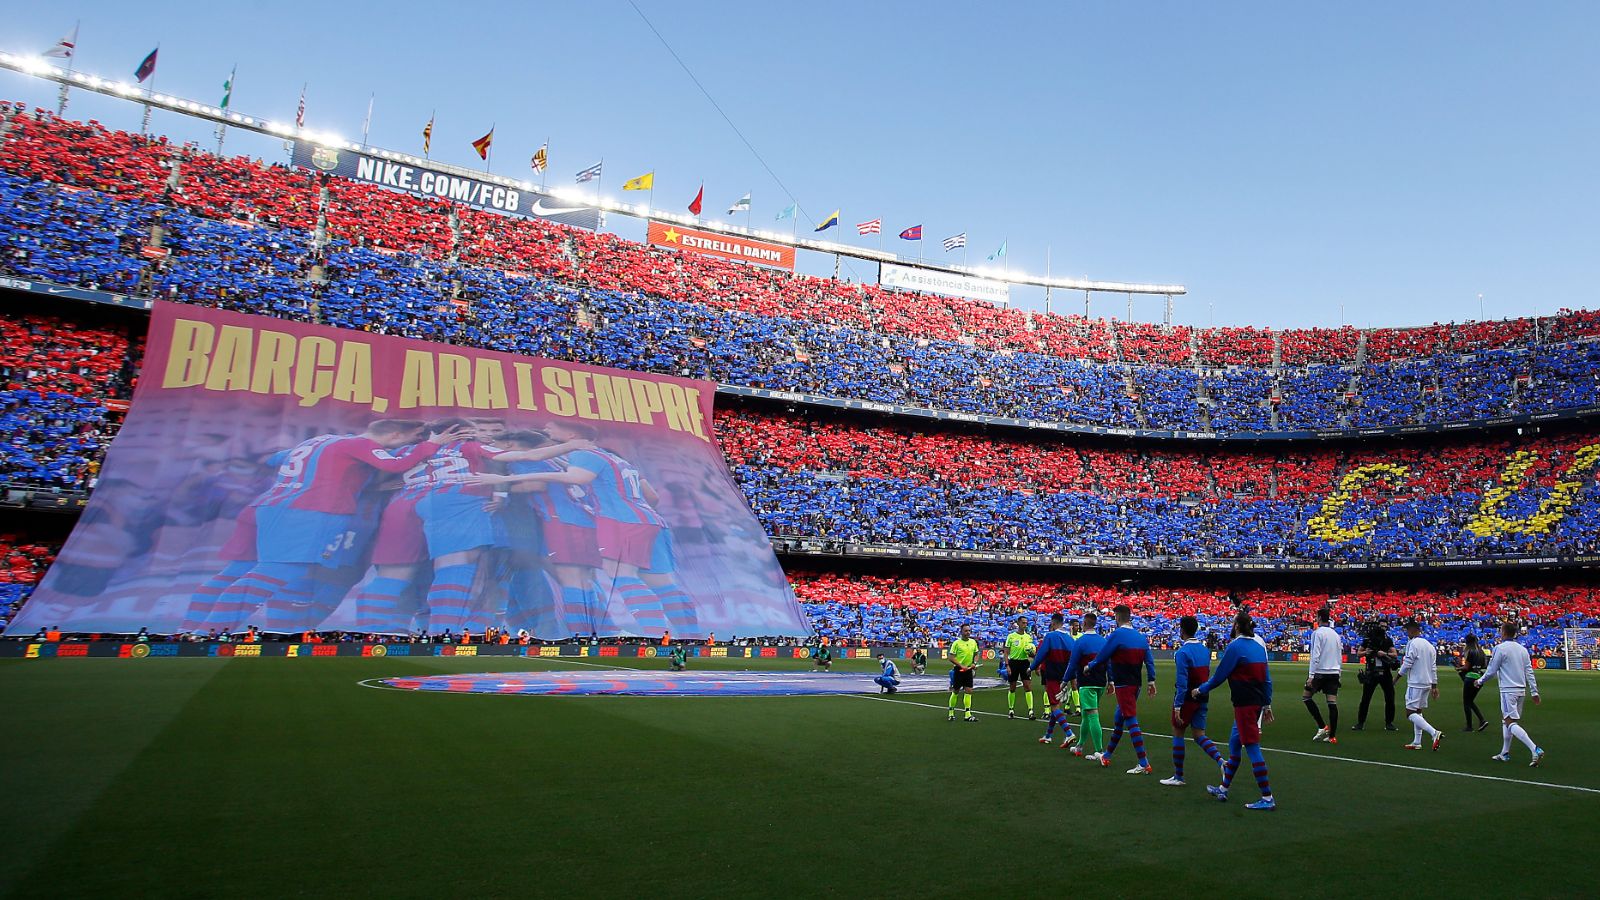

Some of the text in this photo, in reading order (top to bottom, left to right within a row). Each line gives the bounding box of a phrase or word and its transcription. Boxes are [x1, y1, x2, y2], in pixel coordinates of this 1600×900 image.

[356, 157, 519, 211] NIKE.COM/FCB
[681, 235, 781, 262] ESTRELLA DAMM
[162, 318, 710, 443] BARÇA, ARA I SEMPRE
